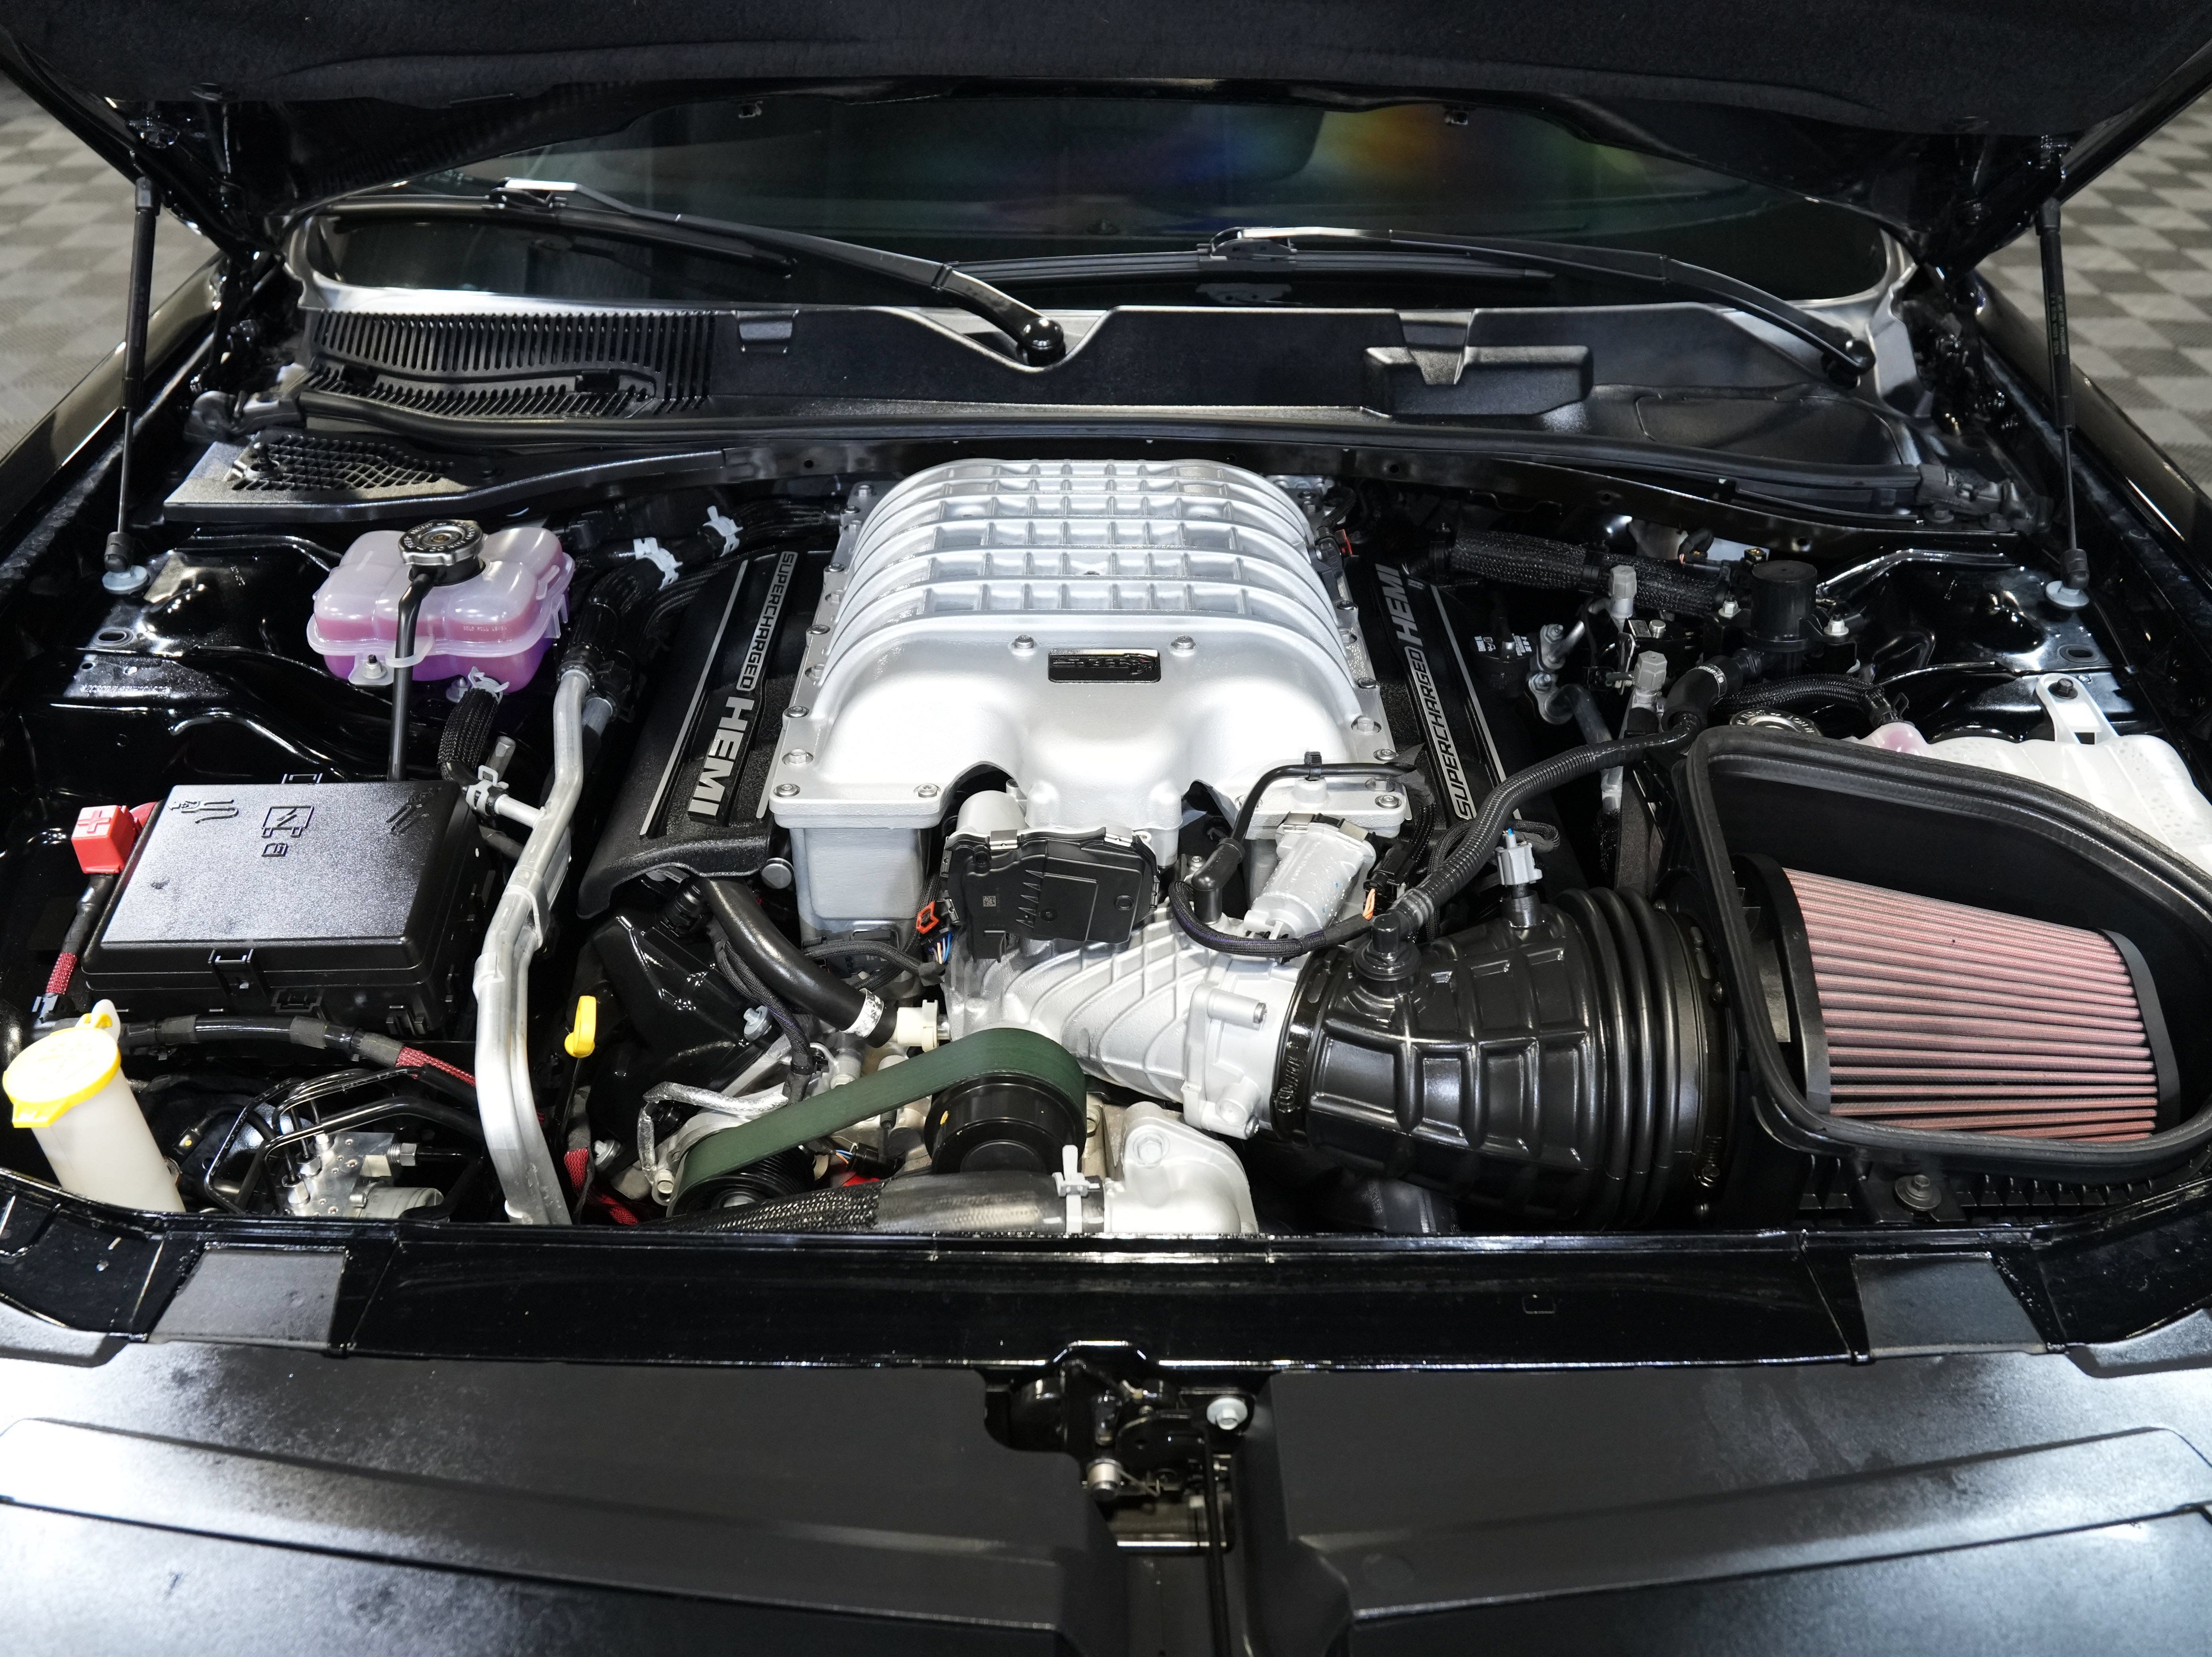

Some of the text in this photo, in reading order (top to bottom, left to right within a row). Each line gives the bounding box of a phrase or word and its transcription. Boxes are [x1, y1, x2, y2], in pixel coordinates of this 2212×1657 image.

[688, 553, 796, 819] SUPERCHARGED HEMI
[1376, 564, 1475, 819] HEMI SUPERCHARGED
